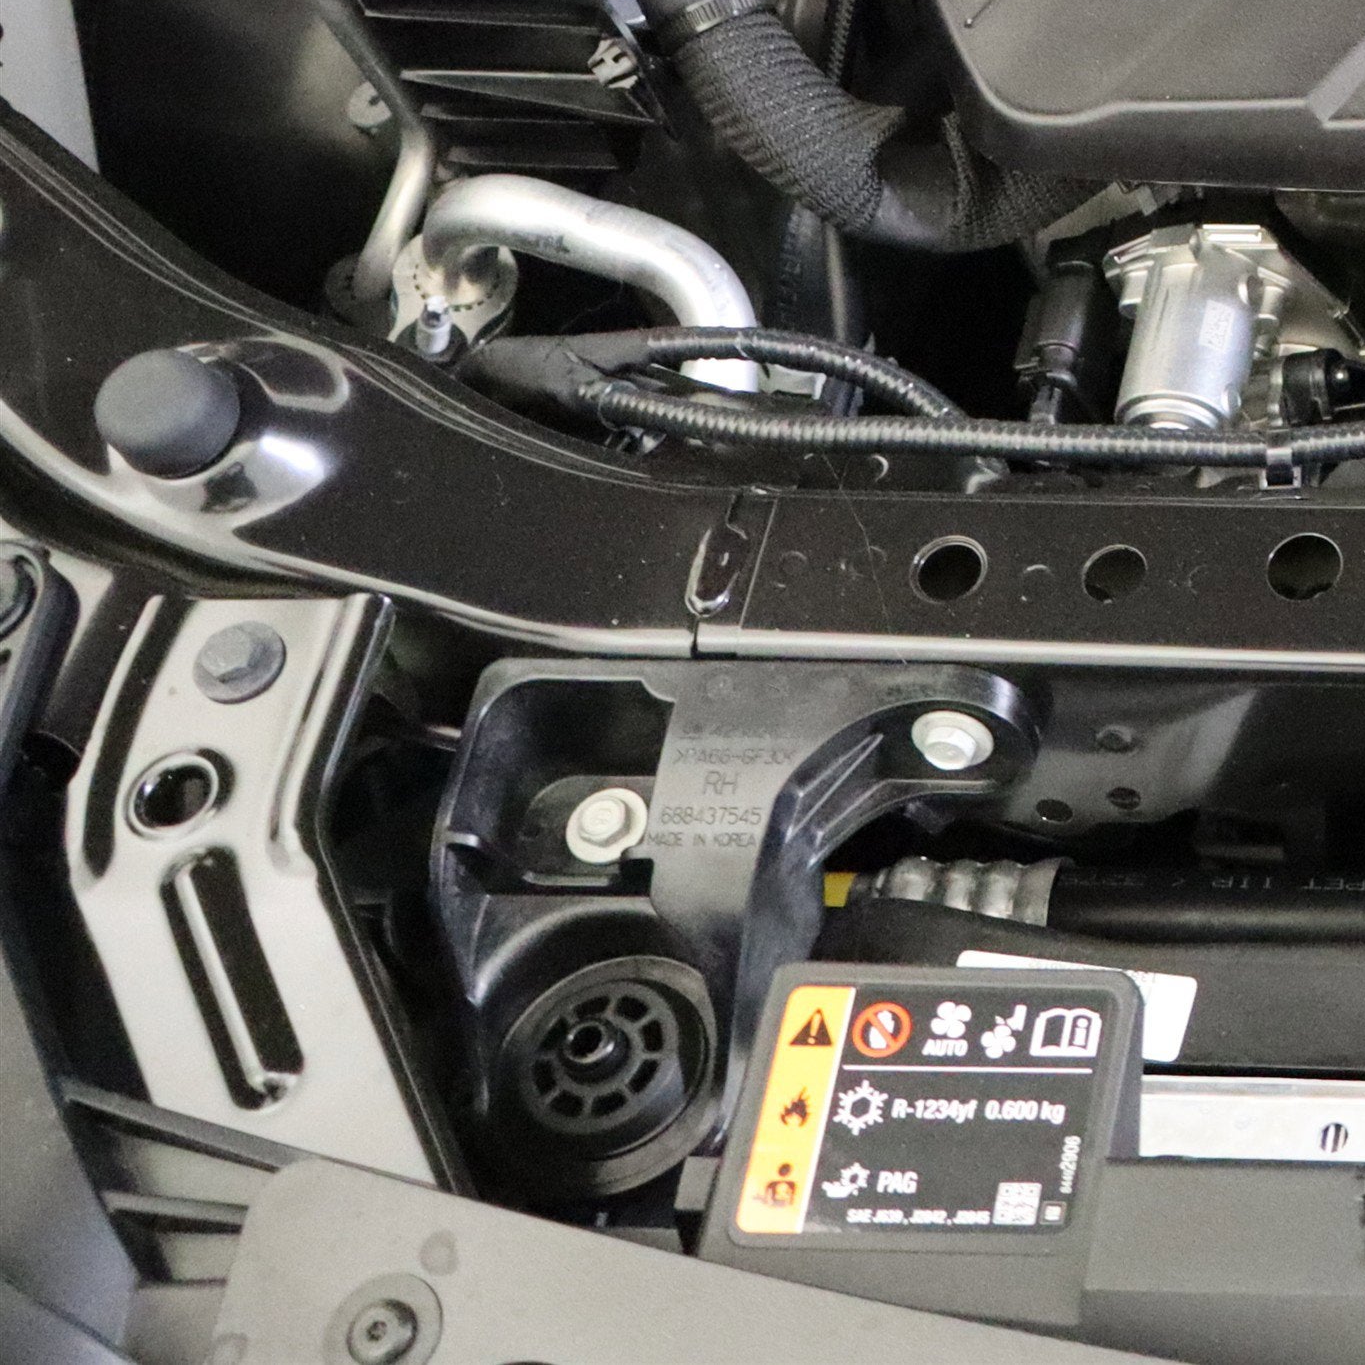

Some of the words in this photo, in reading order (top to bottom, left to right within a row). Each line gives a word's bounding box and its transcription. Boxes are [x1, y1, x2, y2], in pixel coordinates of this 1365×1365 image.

[703, 770, 741, 795] RH
[649, 832, 683, 847] MADE
[693, 833, 706, 847] IN
[713, 832, 757, 847] KOREA
[922, 1039, 969, 1057] AUTO
[891, 1098, 977, 1124] R-1234yf
[985, 1100, 1039, 1121] 0.600
[1041, 1101, 1066, 1125] kg
[876, 1171, 918, 1194] PAG
